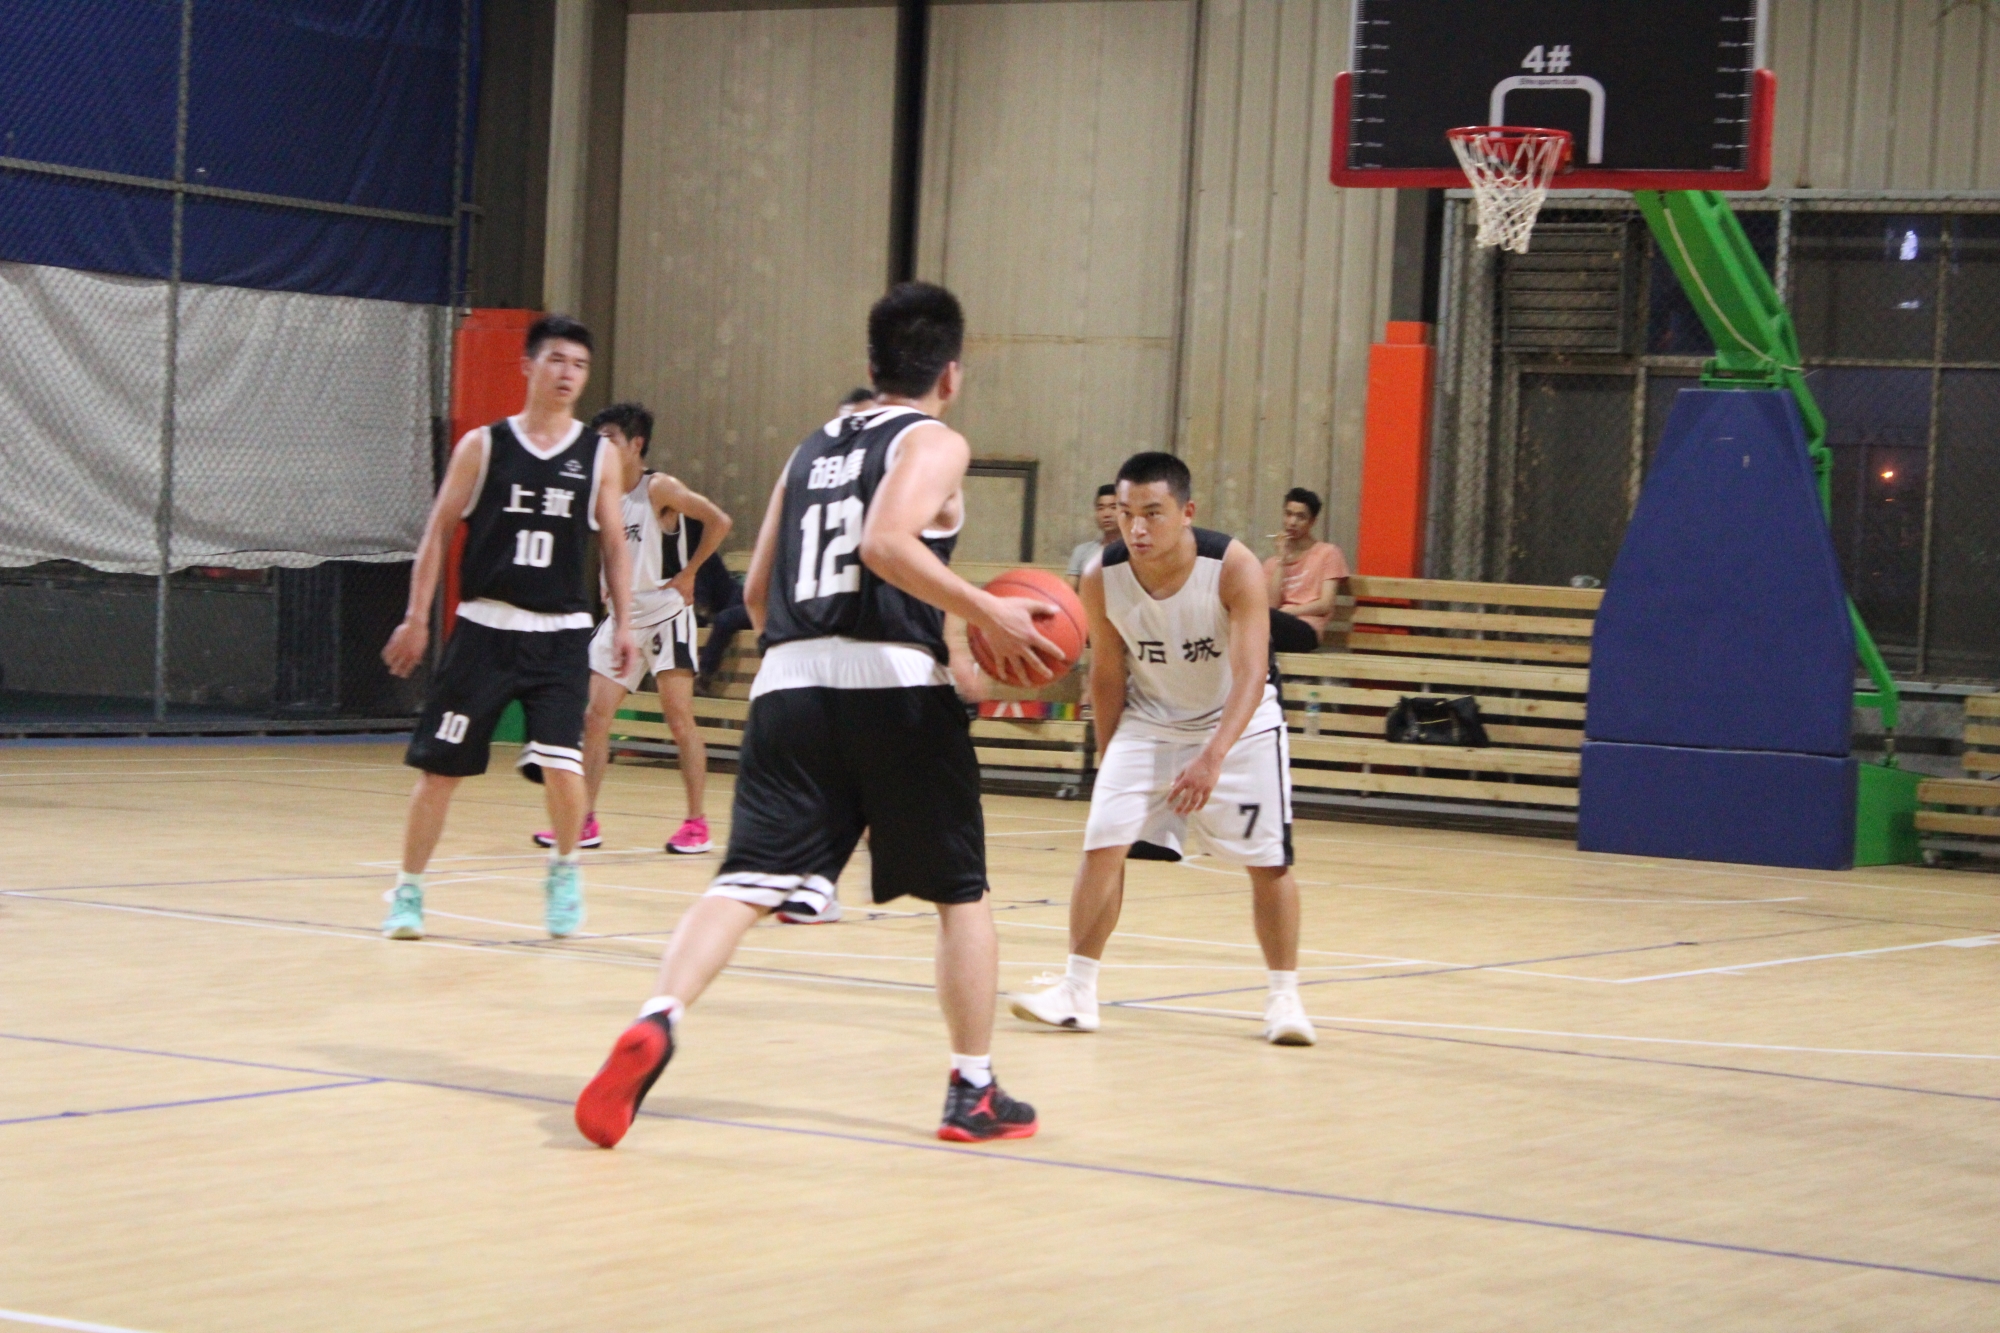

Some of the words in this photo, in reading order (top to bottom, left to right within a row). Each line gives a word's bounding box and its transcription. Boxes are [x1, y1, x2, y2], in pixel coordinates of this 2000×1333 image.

[1521, 45, 1572, 74] 4#
[512, 528, 555, 569] 10
[794, 494, 865, 604] 12
[1136, 636, 1222, 664] 石城
[434, 710, 470, 745] 10
[1238, 802, 1261, 840] 7
